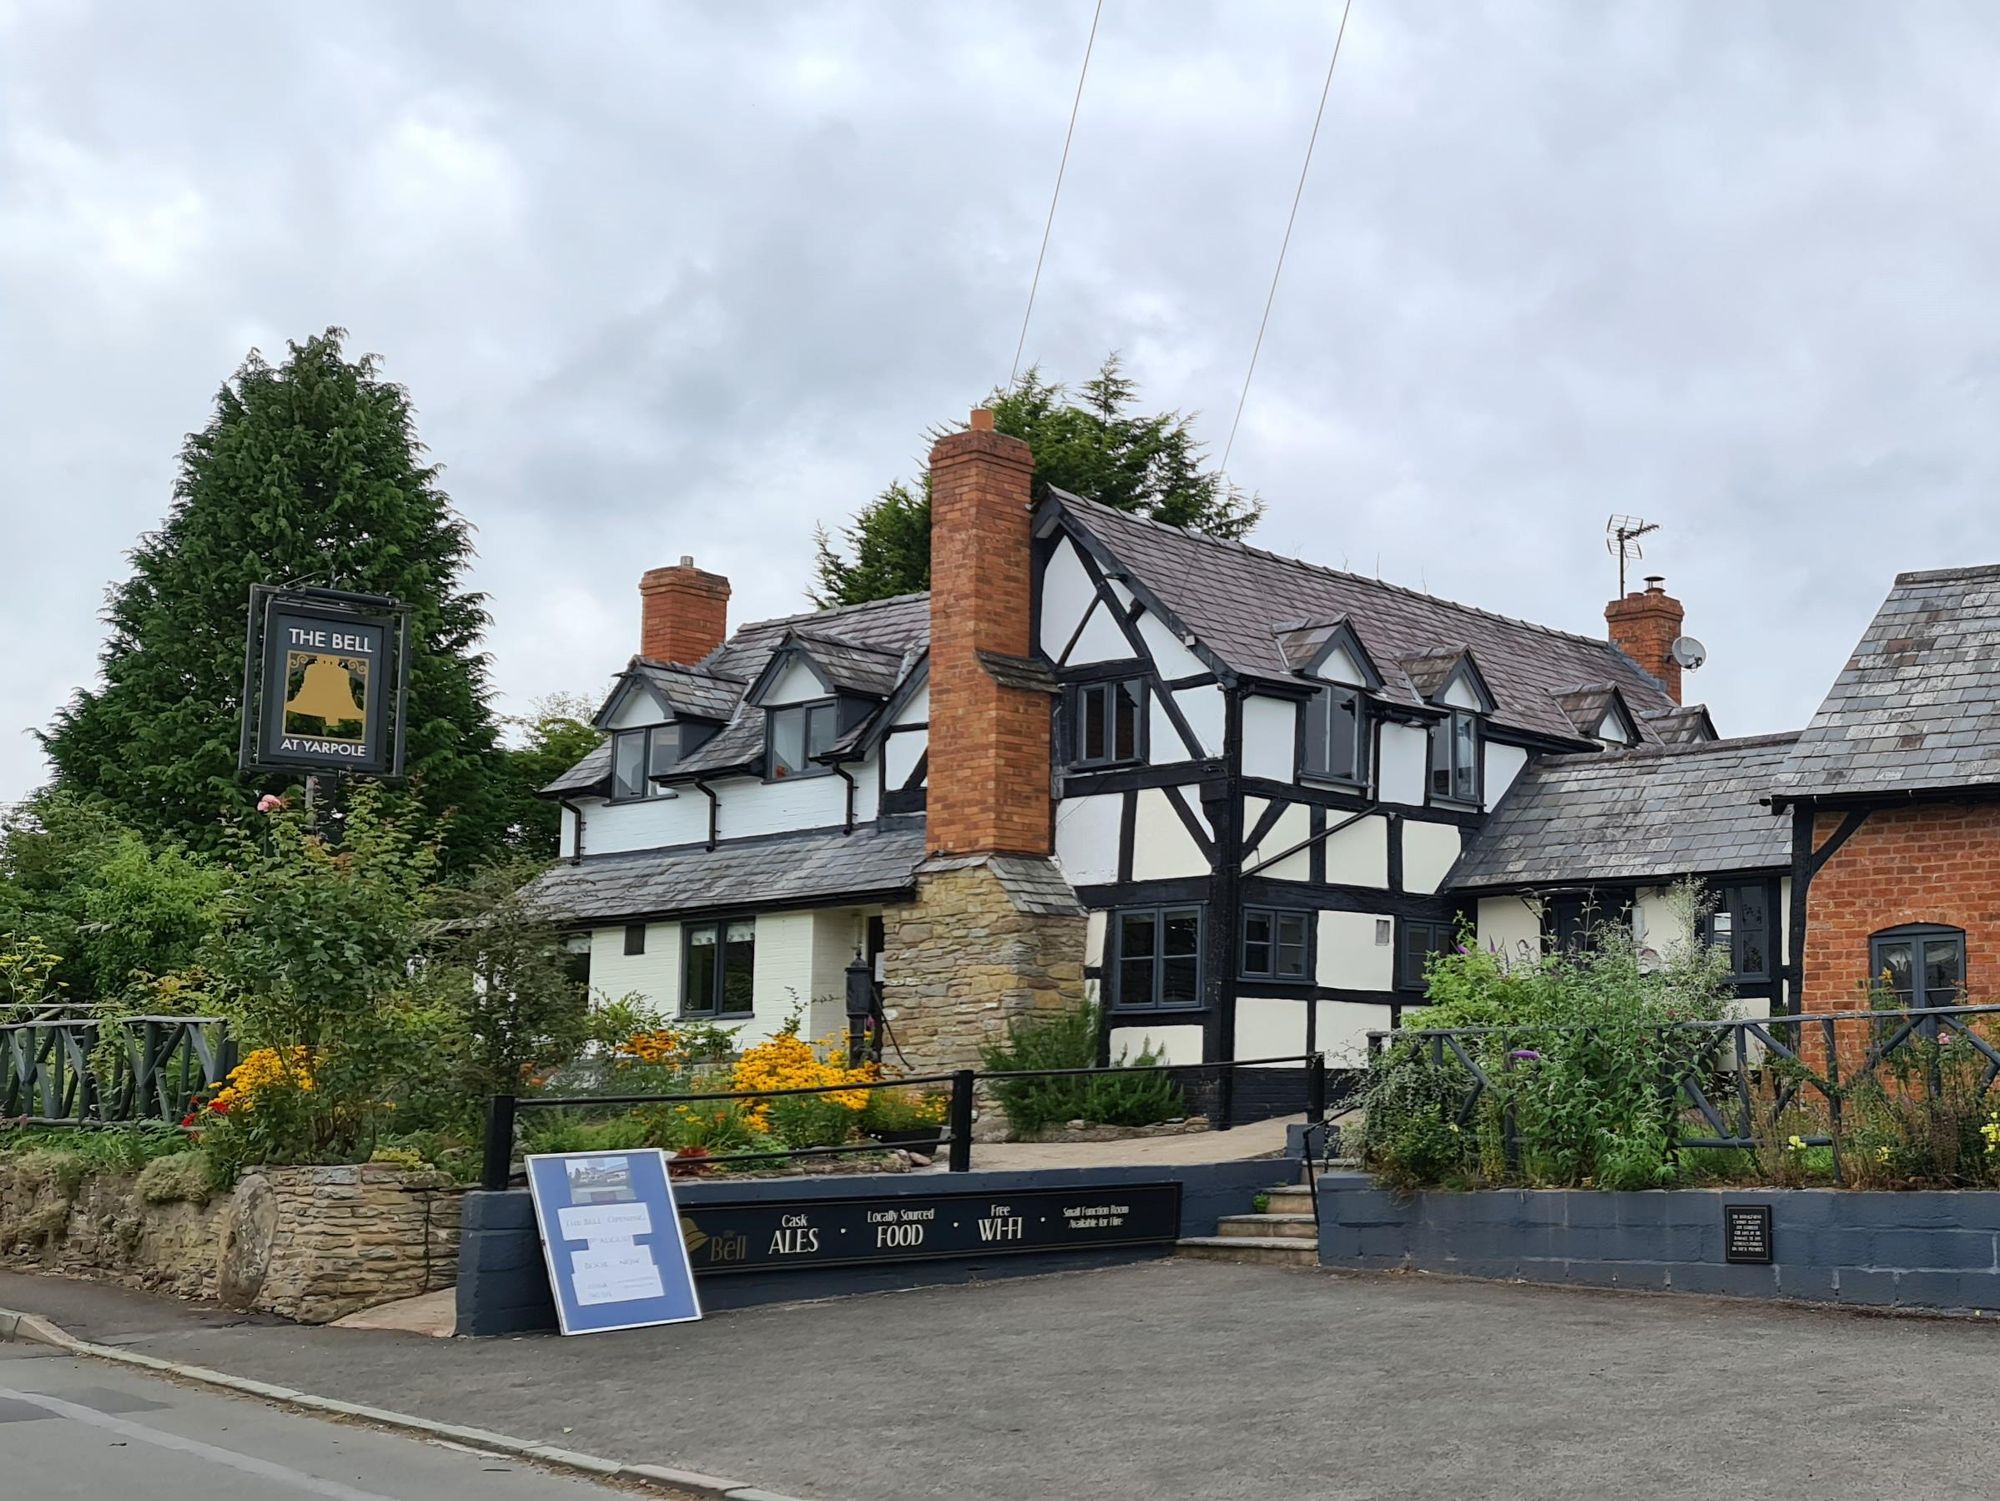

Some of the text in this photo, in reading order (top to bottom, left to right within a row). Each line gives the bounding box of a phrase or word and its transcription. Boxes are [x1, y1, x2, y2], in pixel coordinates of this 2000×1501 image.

[288, 628, 373, 653] THE BELL
[280, 738, 367, 757] AT YARPOLE
[781, 1214, 809, 1228] Cask
[867, 1208, 935, 1224] Locally Sourced
[990, 1204, 1011, 1217] Free
[768, 1228, 819, 1255] ALES
[876, 1223, 924, 1249] FOOD
[978, 1216, 1023, 1242] WI-FI
[710, 1235, 747, 1262] Bell
